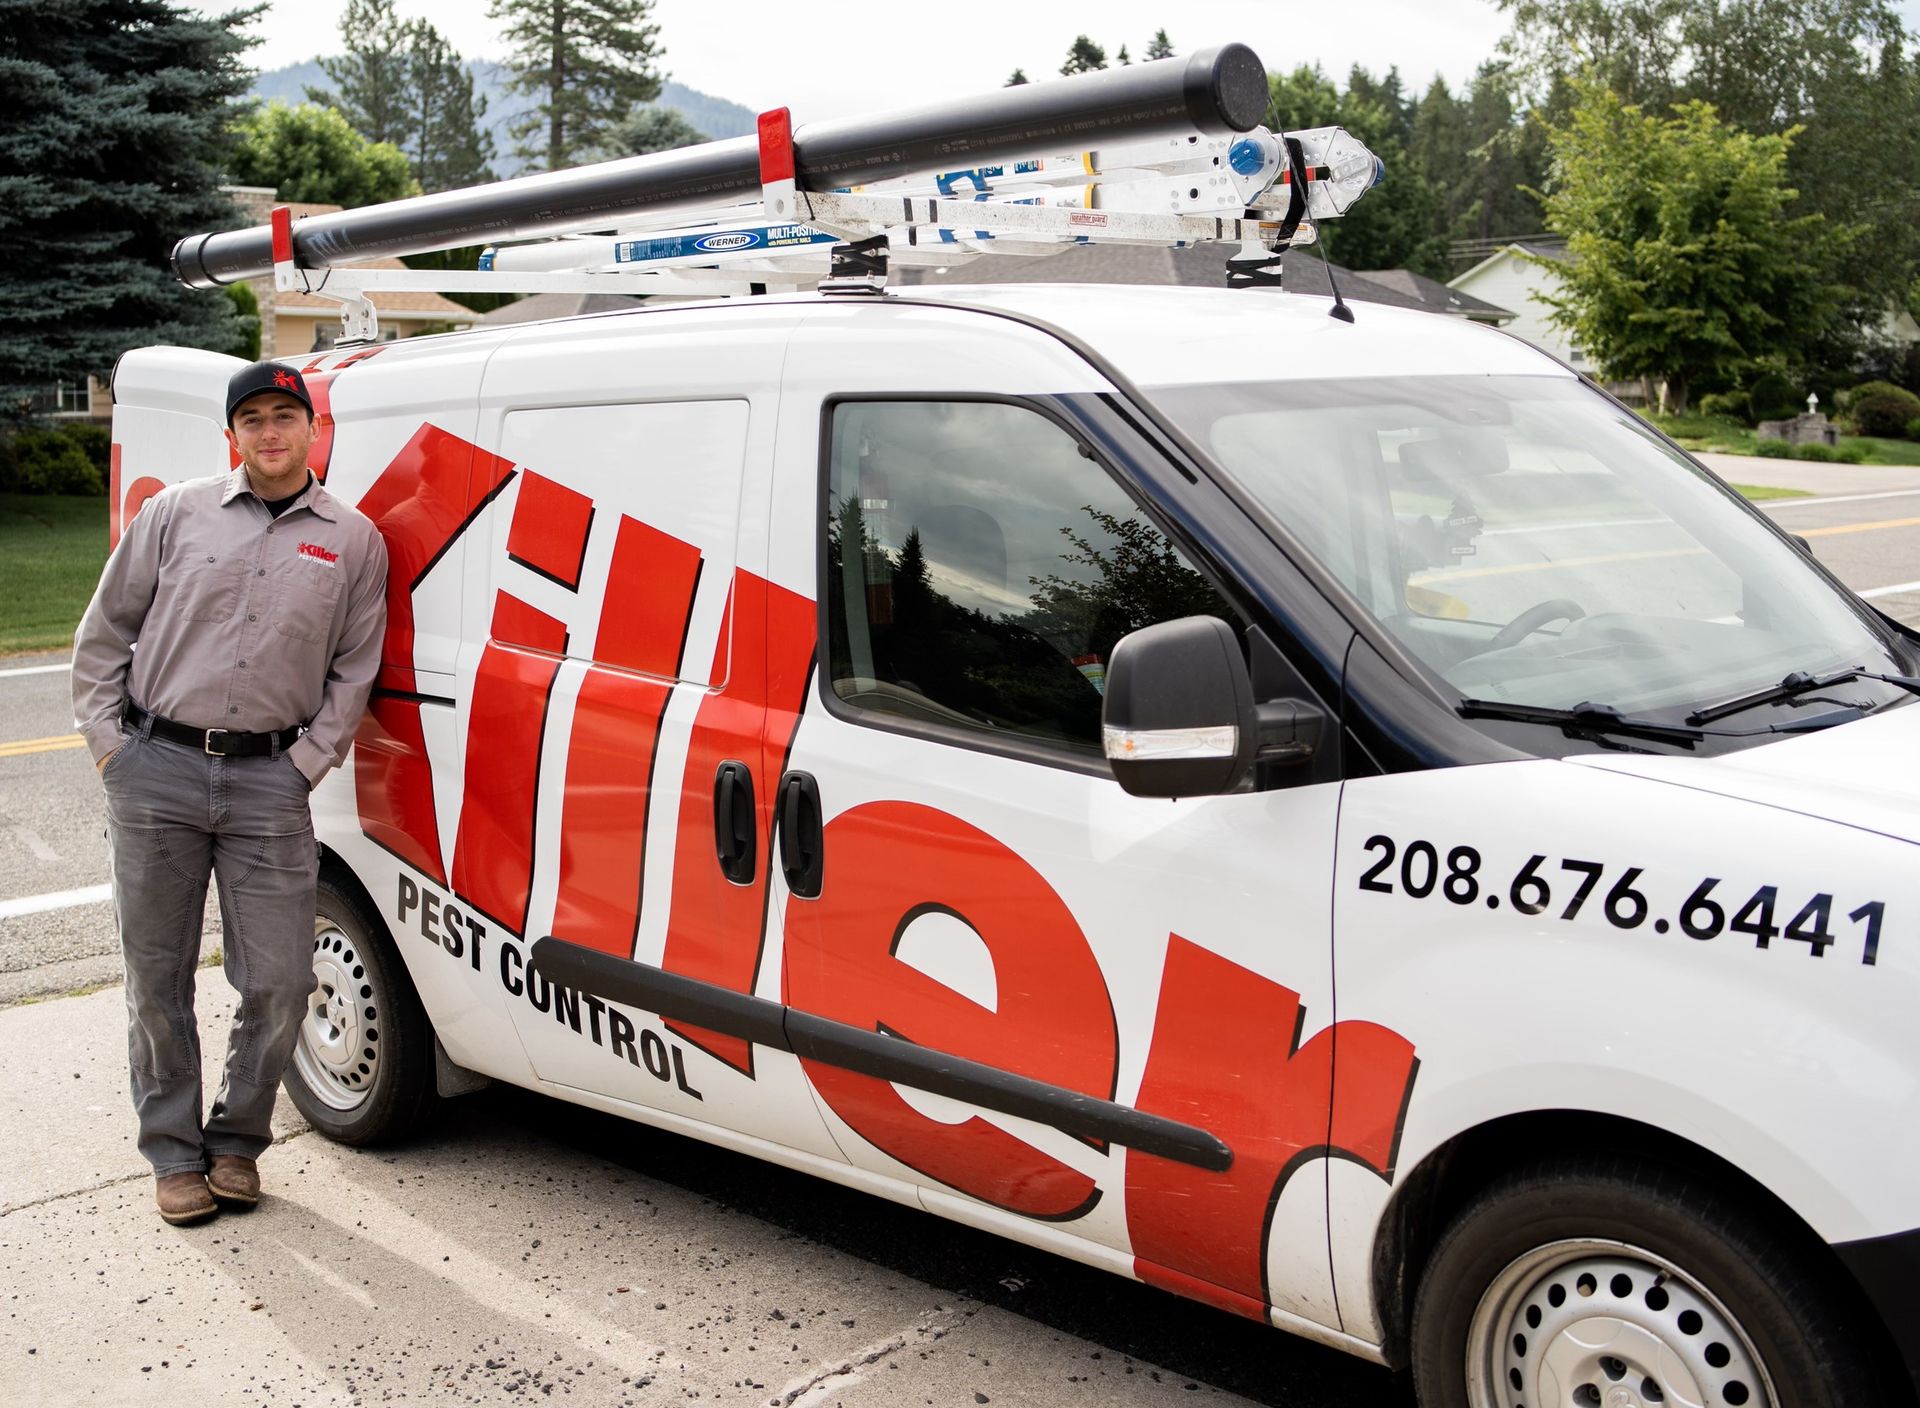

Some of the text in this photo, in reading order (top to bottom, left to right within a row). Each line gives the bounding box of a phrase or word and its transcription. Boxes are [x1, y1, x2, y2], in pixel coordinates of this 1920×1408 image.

[708, 236, 747, 247] WERNER
[767, 225, 823, 239] MULTI-POSITIO
[304, 543, 339, 563] Killer
[354, 421, 1421, 1326] Killer
[1358, 834, 1886, 967] 208.676.6441
[397, 871, 705, 1103] PEST CONTROL
